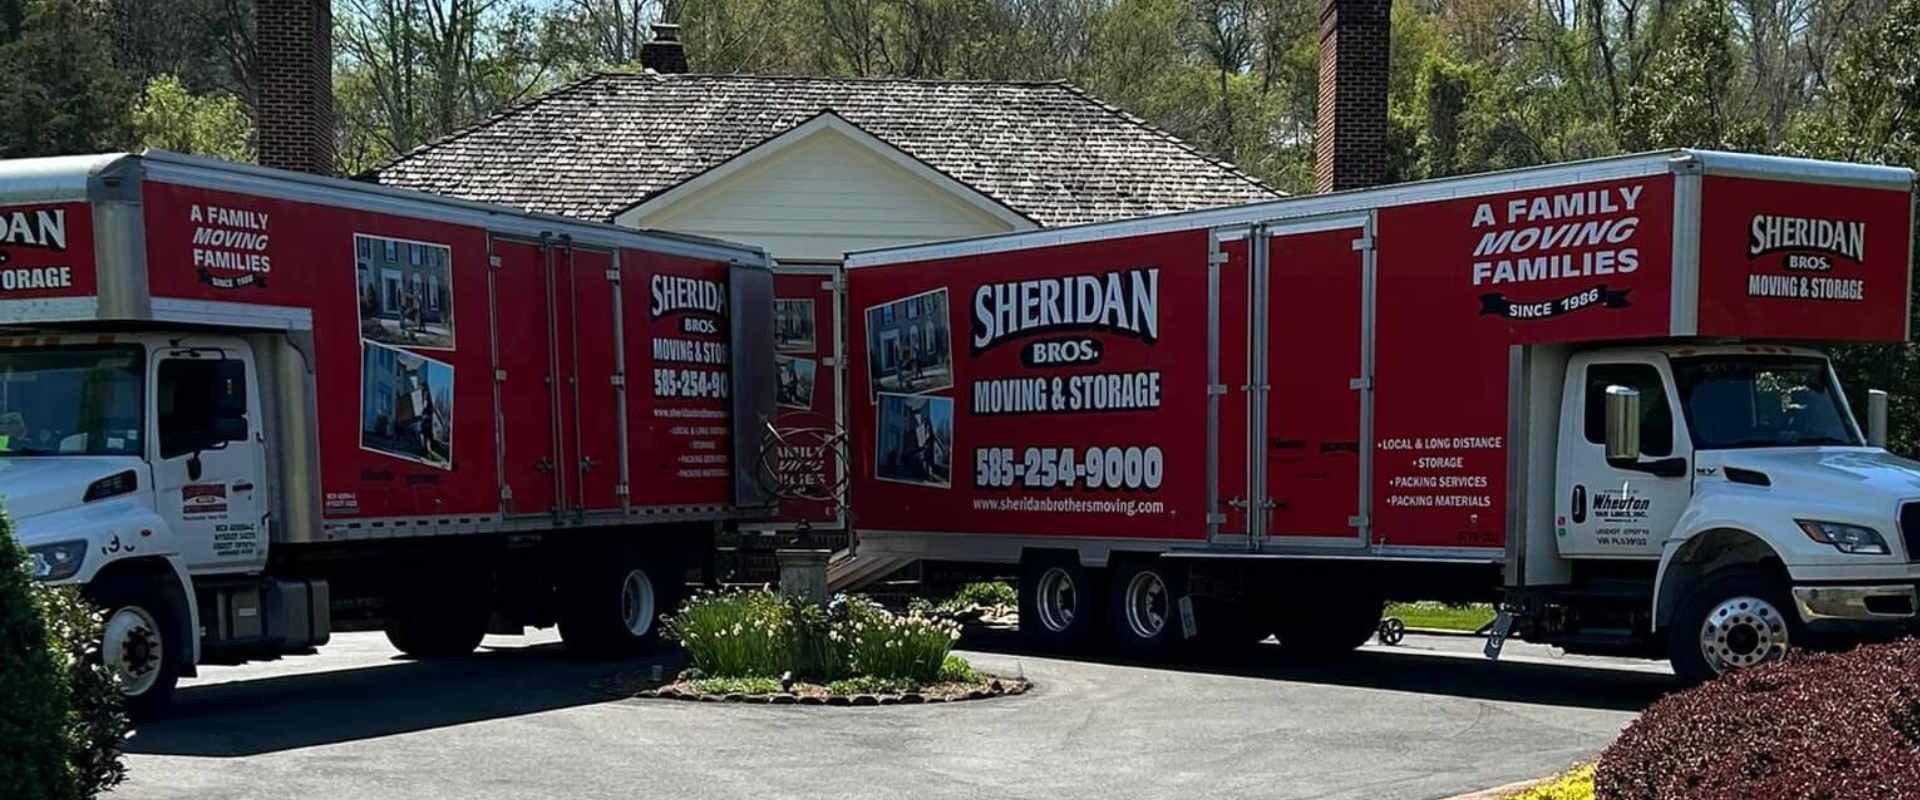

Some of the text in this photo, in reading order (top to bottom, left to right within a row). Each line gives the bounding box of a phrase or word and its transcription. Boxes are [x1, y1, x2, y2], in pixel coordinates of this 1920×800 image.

[190, 204, 269, 230] A FAMILY
[1472, 185, 1643, 228] A FAMILY
[192, 226, 270, 251] MOVING
[1472, 217, 1640, 257] MOVING
[1750, 213, 1865, 262] SHERIDAN
[193, 248, 272, 273] FAMILIES
[1473, 248, 1640, 286] FAMILIES
[1789, 255, 1831, 270] BROS.
[1749, 274, 1864, 300] MOVING & STORAGE
[974, 268, 1160, 349] SHERIDAN
[1509, 288, 1599, 318] SINCE 1986
[684, 317, 718, 334] BROS.
[653, 337, 693, 361] MOVING
[694, 340, 703, 363] &
[1033, 339, 1099, 364] BROS.
[974, 372, 1161, 414] MOVING & STORAGE
[1383, 436, 1503, 450] LOCAL & LONG DISTANCE
[976, 446, 1163, 489] 585-254-9000
[1418, 457, 1464, 469] STORAGE
[1394, 476, 1488, 488] PACKING SERVICES
[973, 496, 1164, 516] www.sheridanbrothersmoving.com
[1391, 495, 1491, 507] PACKING MATERIALS
